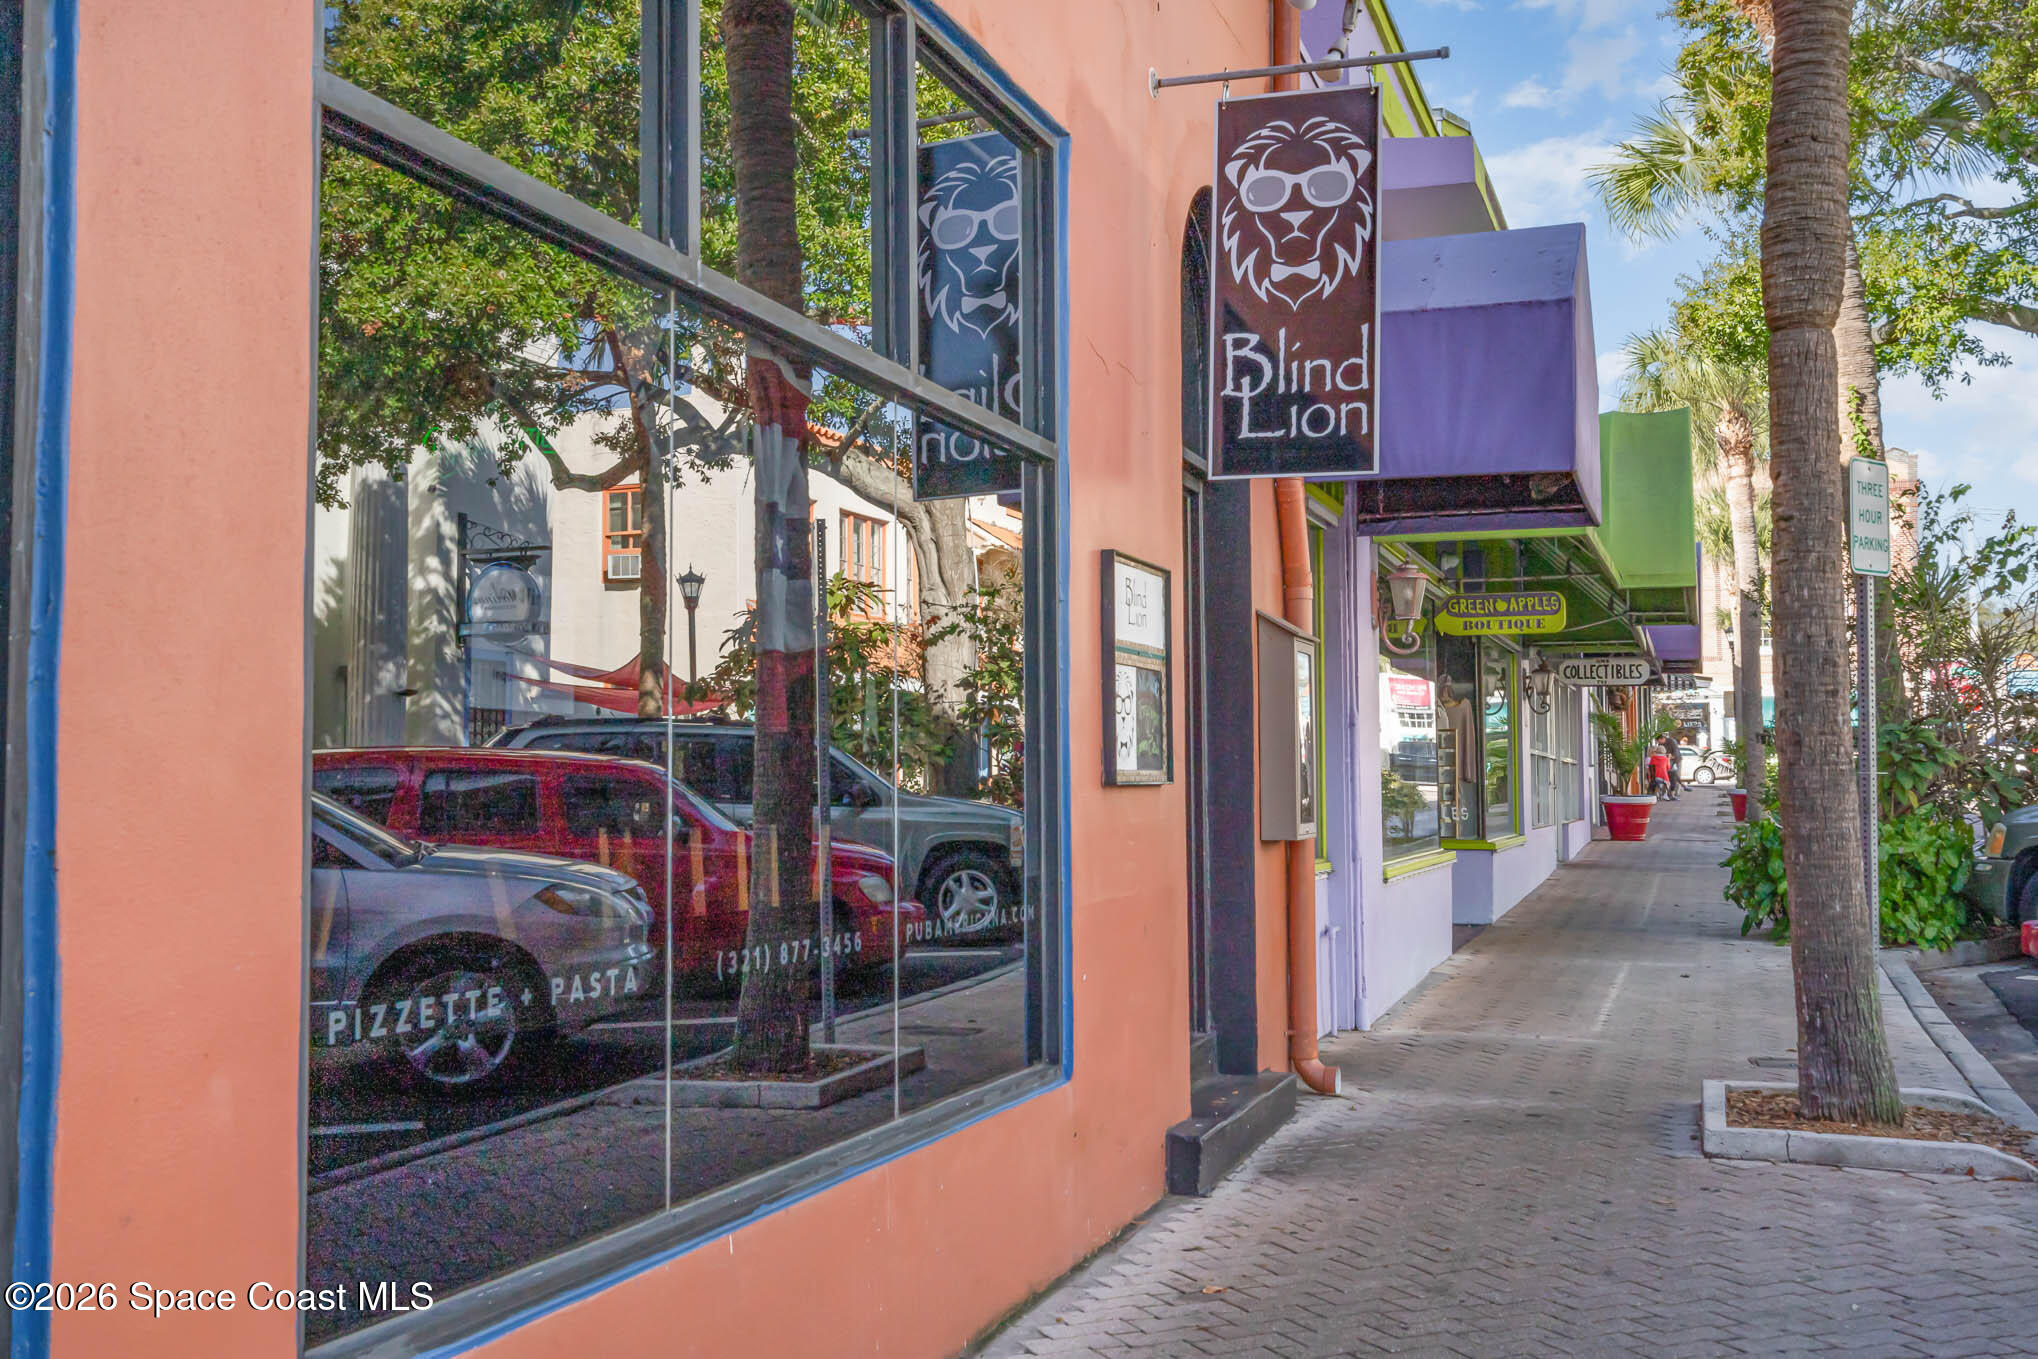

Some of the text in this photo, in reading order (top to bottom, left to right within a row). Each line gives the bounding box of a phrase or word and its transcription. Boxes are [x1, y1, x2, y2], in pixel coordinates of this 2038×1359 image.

[1220, 323, 1369, 398] Blind
[1238, 376, 1369, 439] Lion
[1857, 481, 1883, 498] THREE
[1859, 508, 1883, 525] HOUR
[1853, 535, 1889, 553] PARKING
[1125, 576, 1147, 608] Blind
[1128, 598, 1148, 628] Lion
[1448, 596, 1559, 614] GREEN APPLES
[1463, 618, 1546, 632] BOUTIQUE
[1563, 664, 1643, 680] COLLECTIBLES
[716, 943, 770, 981] (321)
[328, 986, 504, 1046] PIZZETTE
[551, 966, 639, 1006] PASTA
